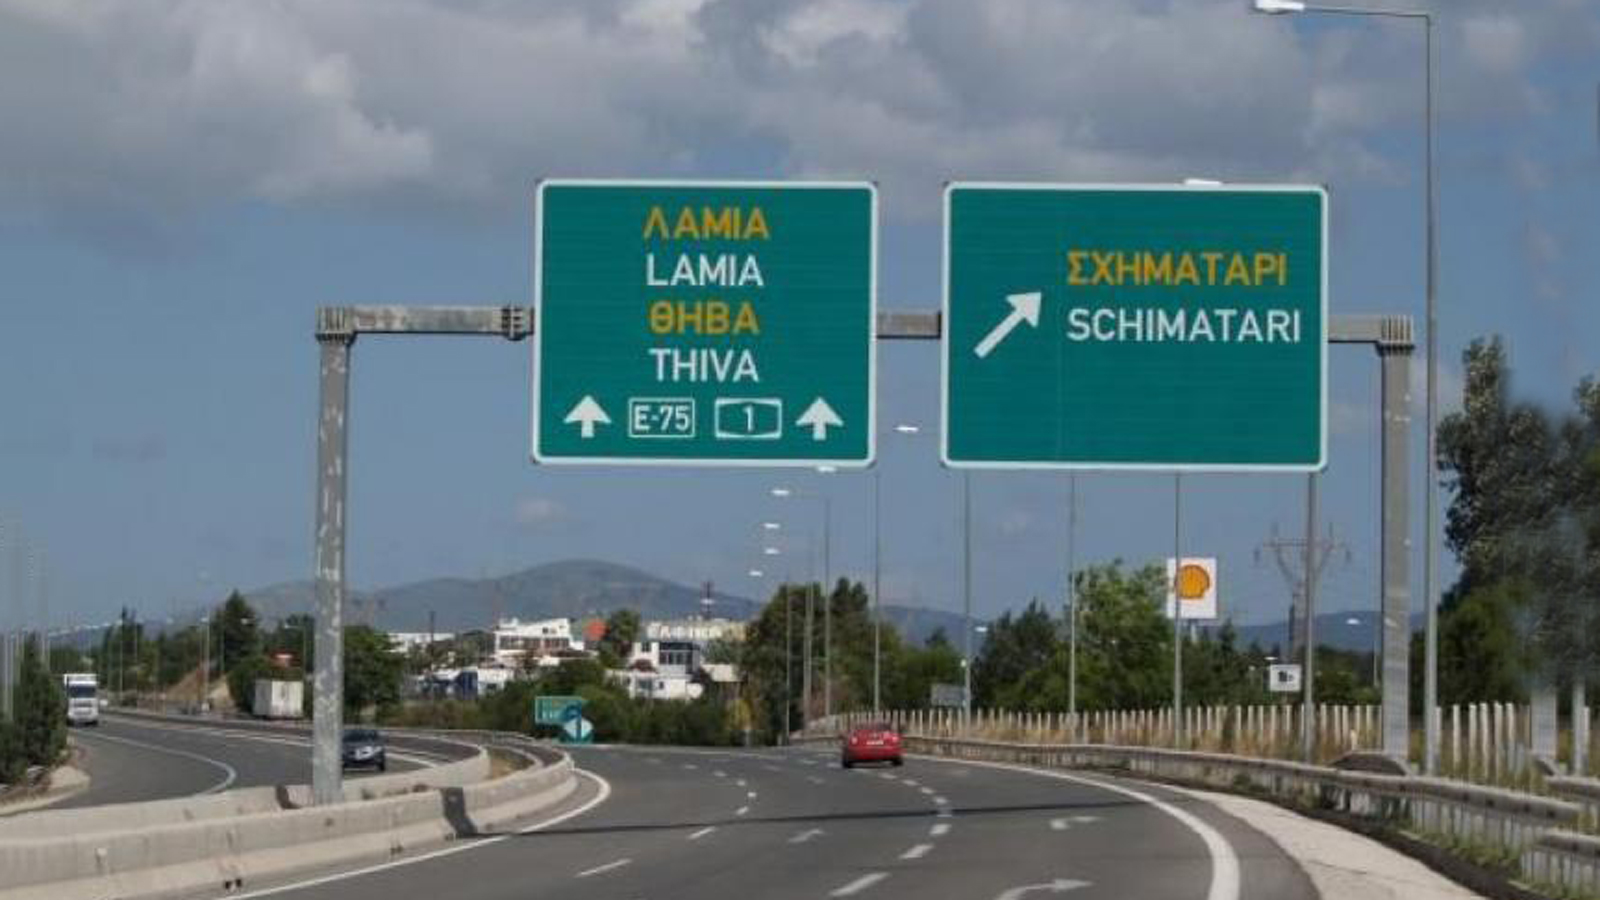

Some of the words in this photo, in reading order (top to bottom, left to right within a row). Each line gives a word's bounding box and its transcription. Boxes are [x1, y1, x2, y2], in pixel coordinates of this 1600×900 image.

[643, 206, 769, 239] ΛΑΜΙΑ
[647, 253, 764, 286] LAMIA
[1067, 250, 1287, 285] ΣΧΗΜΑΤΑΡΙ
[650, 301, 760, 334] ΘΗΒΑ
[1067, 308, 1300, 343] SCHIMATARI
[649, 348, 759, 382] THIVA
[634, 405, 691, 431] E-75
[743, 405, 754, 431] 1
